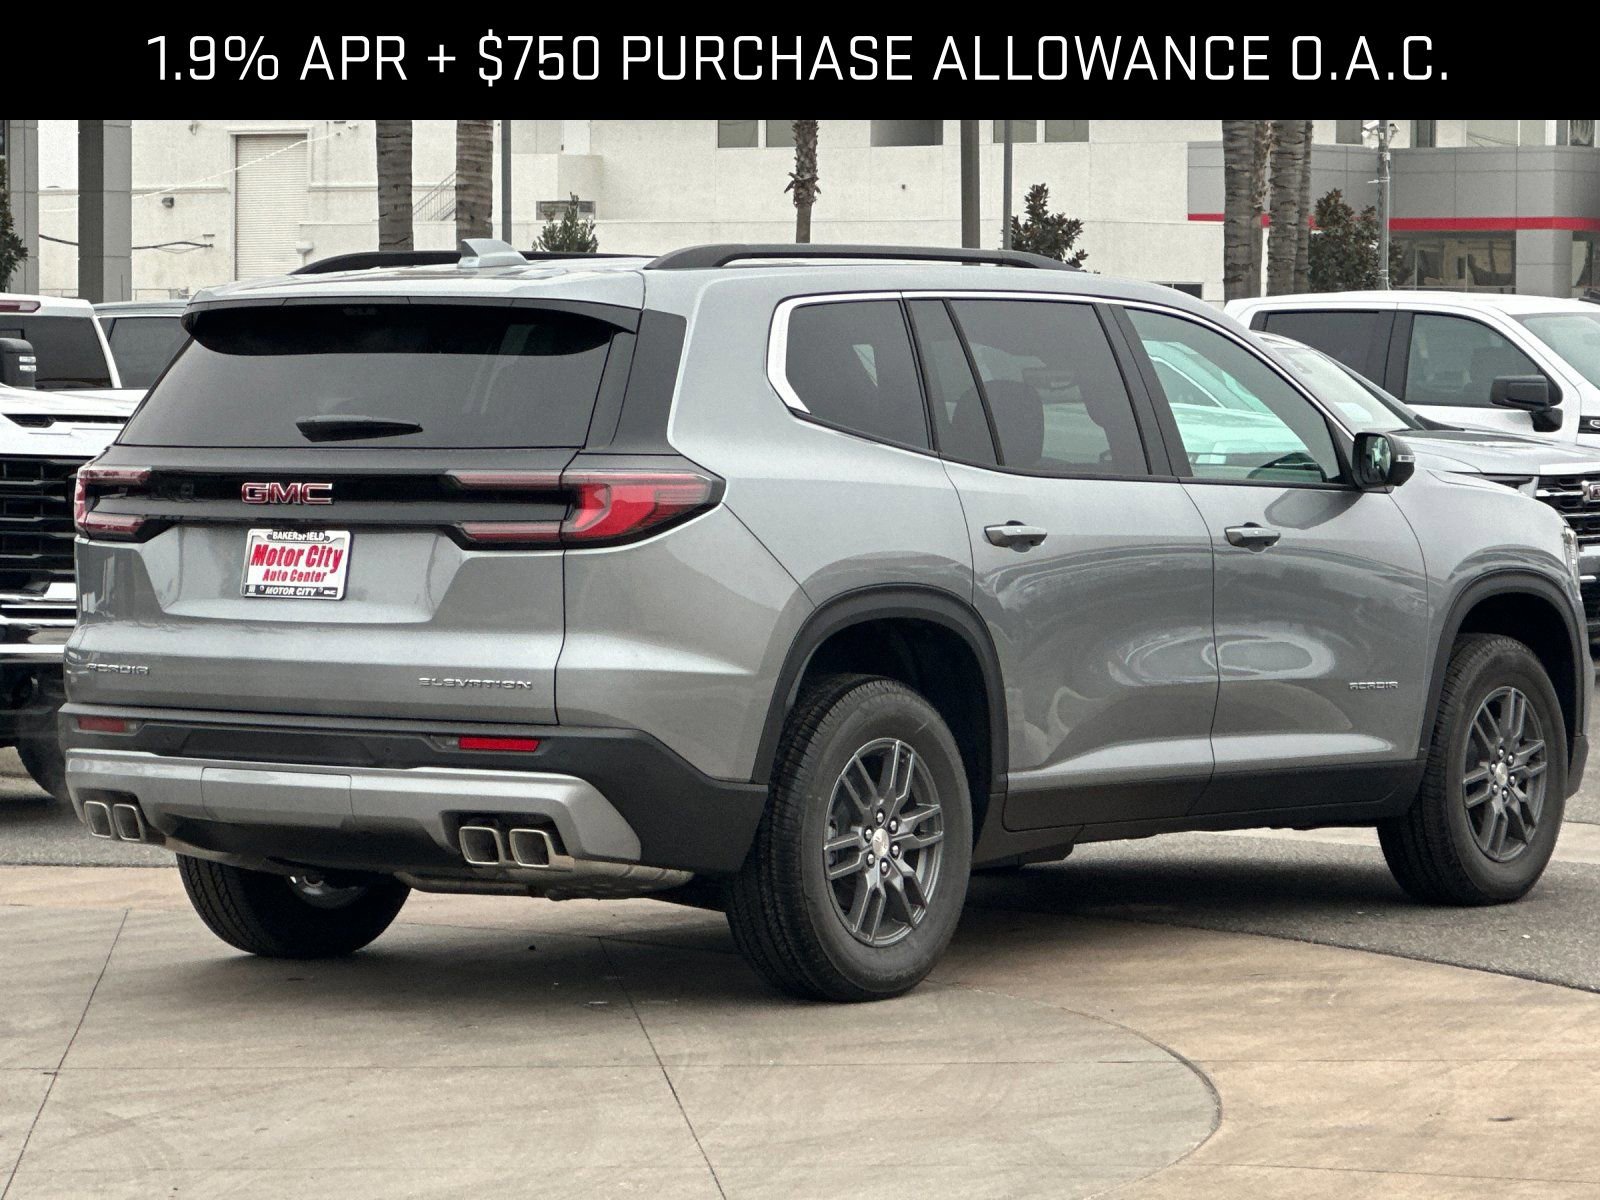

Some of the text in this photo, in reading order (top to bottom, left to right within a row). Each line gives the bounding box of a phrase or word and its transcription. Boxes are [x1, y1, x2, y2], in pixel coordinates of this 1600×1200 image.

[241, 482, 333, 505] GMC
[272, 531, 325, 541] BAKERSFIELD
[250, 544, 344, 574] Motor City
[262, 568, 327, 583] Auto Center
[265, 586, 295, 595] MOTOR
[295, 587, 317, 596] CITY
[418, 677, 532, 690] ELEVATION
[1349, 681, 1399, 690] ACADIA
